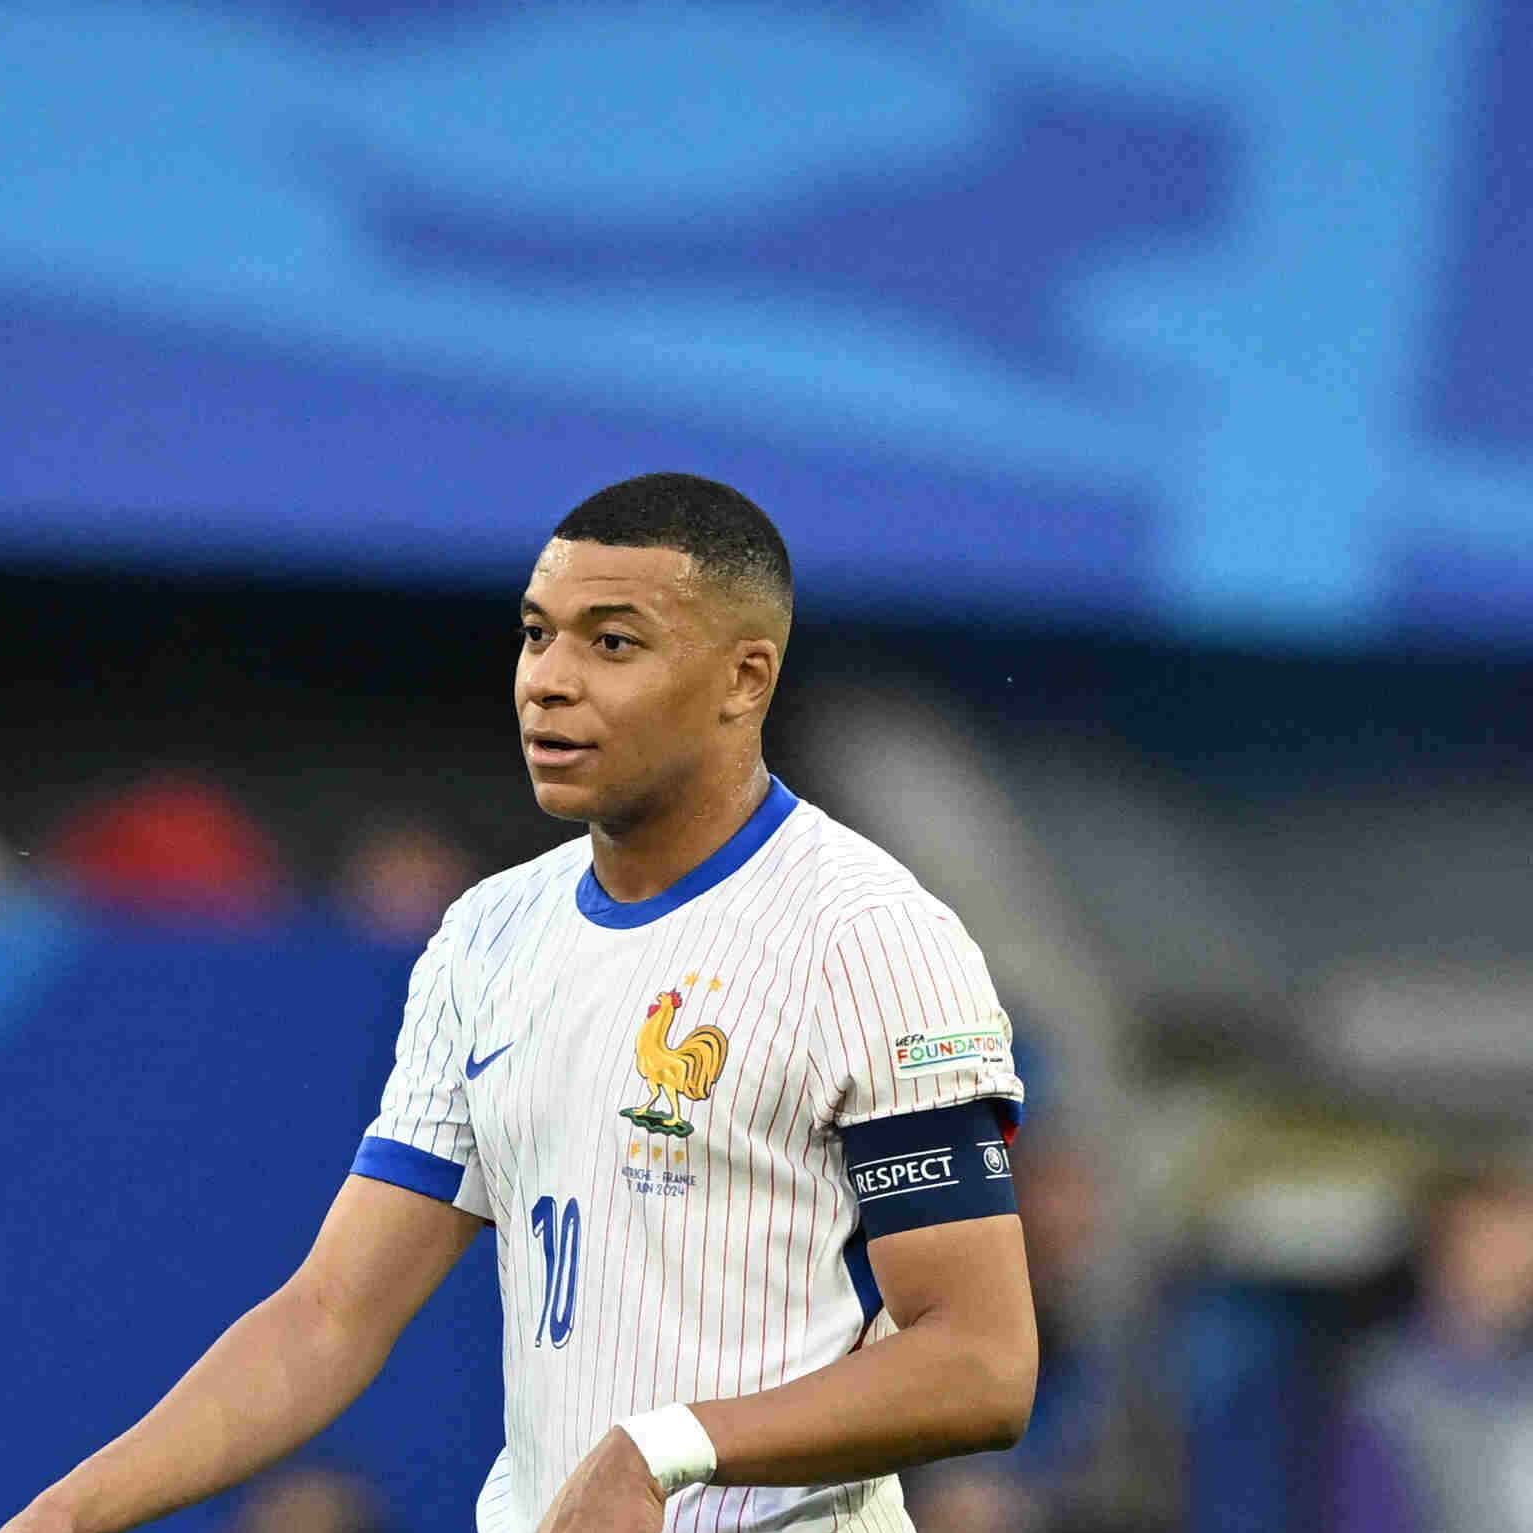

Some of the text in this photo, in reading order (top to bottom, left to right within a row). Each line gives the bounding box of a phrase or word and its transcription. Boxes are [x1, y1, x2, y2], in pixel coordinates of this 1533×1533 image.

[895, 1034, 925, 1047] UEFA
[897, 1037, 1003, 1064] FOUNDATION
[855, 1155, 953, 1194] RESPECT
[655, 1183, 684, 1197] 2024
[531, 1196, 581, 1349] 10
